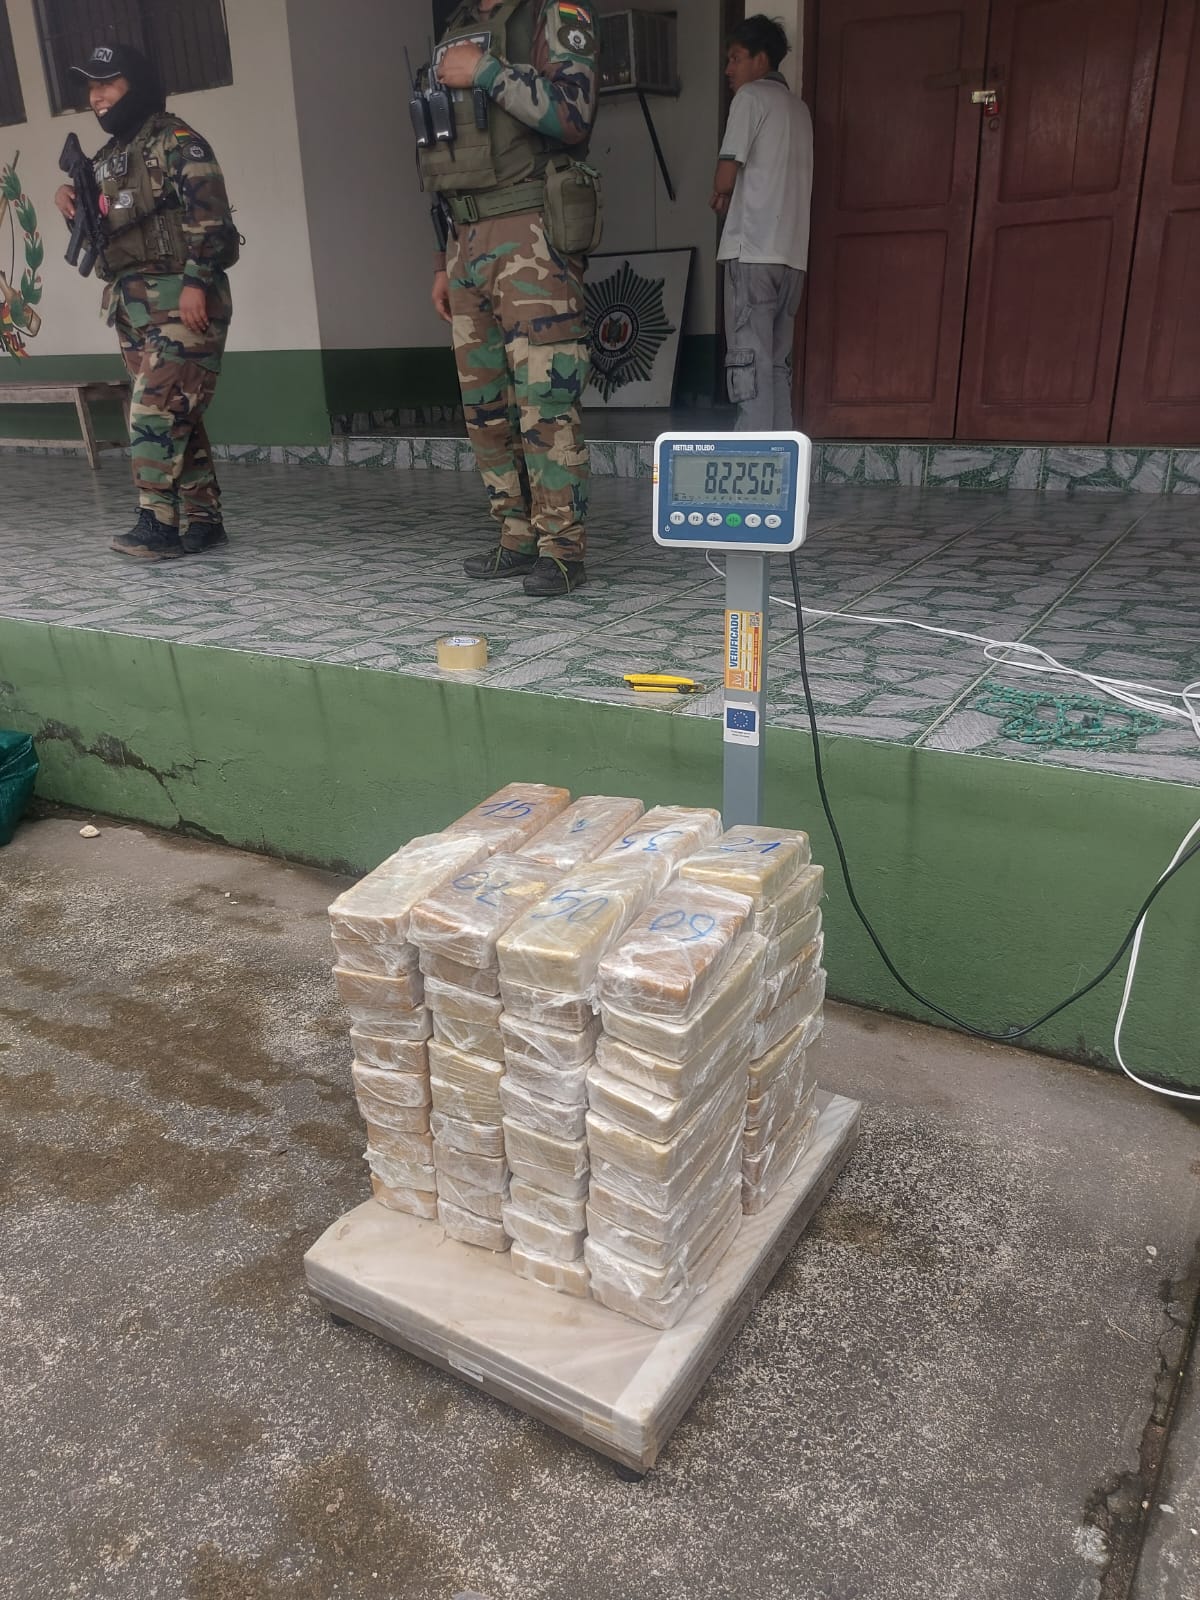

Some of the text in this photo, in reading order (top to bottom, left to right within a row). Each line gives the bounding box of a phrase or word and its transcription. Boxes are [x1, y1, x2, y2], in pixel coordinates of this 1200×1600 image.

[729, 613, 739, 668] VERIFICADO
[478, 799, 537, 819] 15
[720, 836, 781, 853] 21
[530, 889, 609, 922] 50
